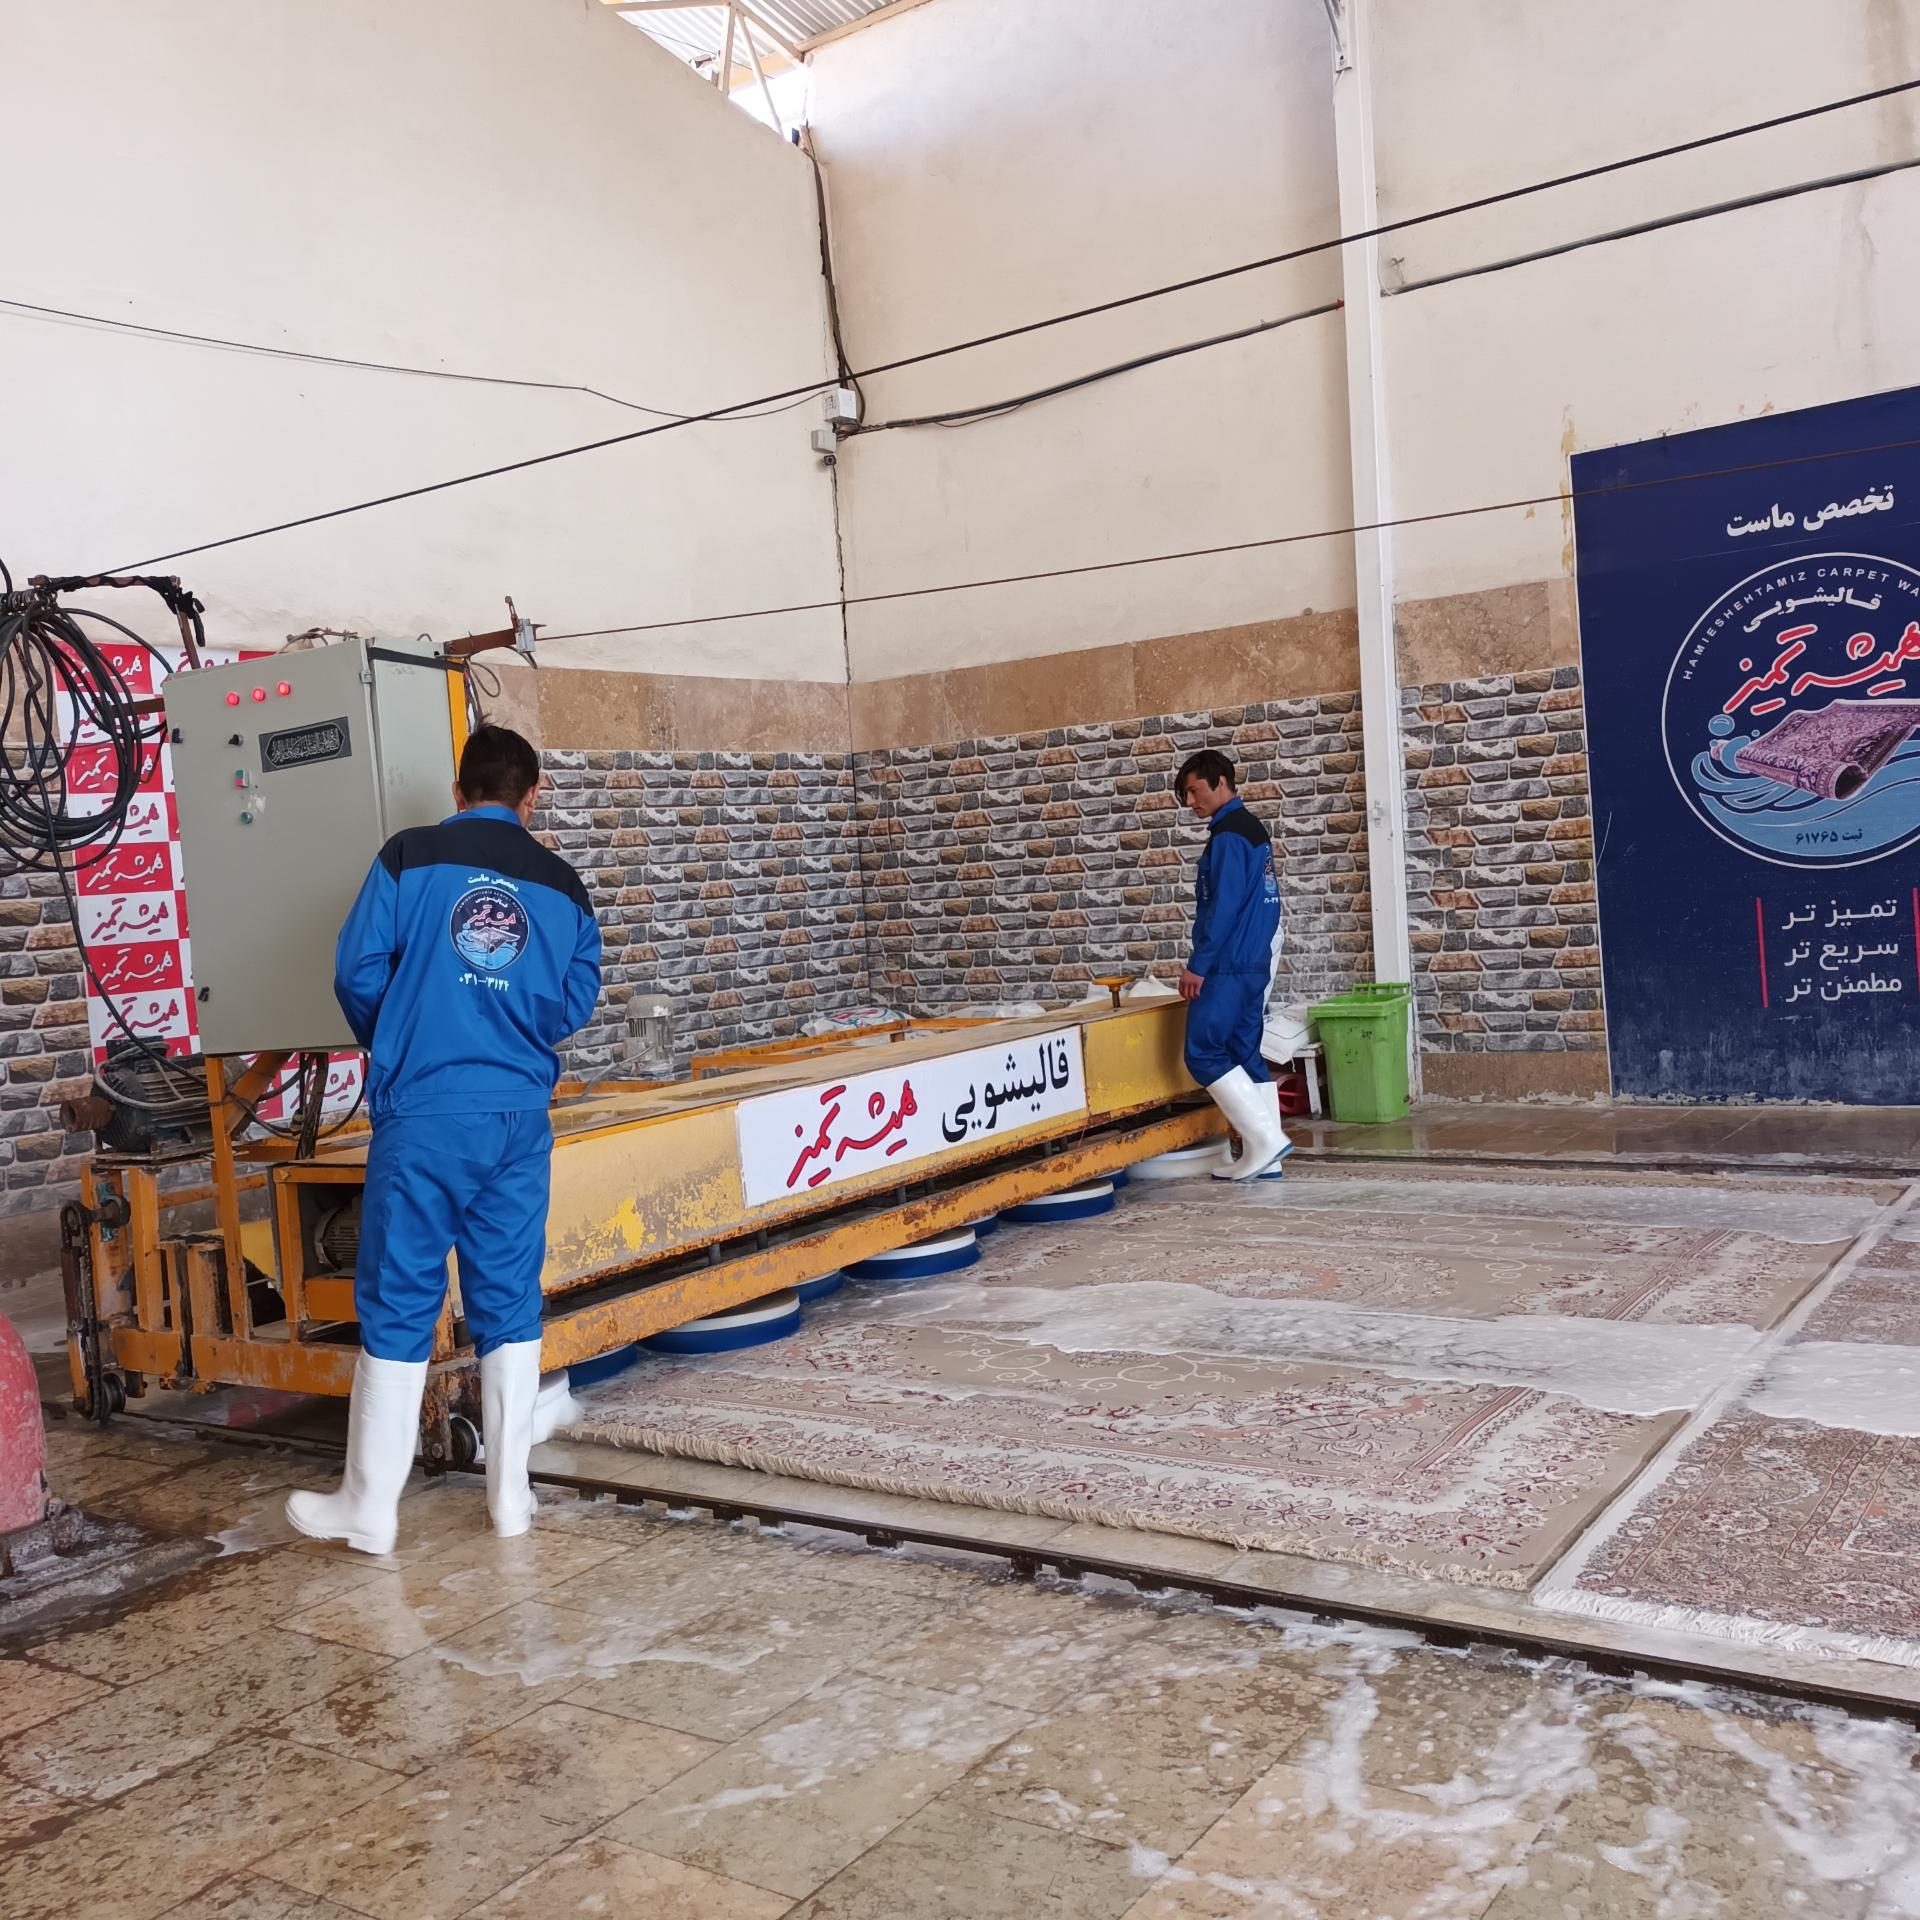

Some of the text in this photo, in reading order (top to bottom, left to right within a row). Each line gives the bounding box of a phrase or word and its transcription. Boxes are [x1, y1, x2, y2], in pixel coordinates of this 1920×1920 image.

[1726, 485, 1895, 537] تخصص ماست
[1683, 571, 1807, 680] HAMIESHEHTAMIZ
[1817, 567, 1890, 583] CARPET
[1743, 586, 1883, 633] قالیشویی
[1722, 623, 1818, 714] تمیز
[1795, 828, 1864, 845] ثبت ۶۱۷۶۵
[114, 852, 164, 886] همیشه
[91, 897, 169, 941] همیشه تمیز
[1781, 899, 1898, 930] تمیز تر
[124, 950, 173, 984] همیشه
[1784, 941, 1899, 971] سریع تر
[1785, 972, 1902, 1003] مطمئن تر
[787, 1037, 1069, 1188] قالیشویی همیشه تمیز
